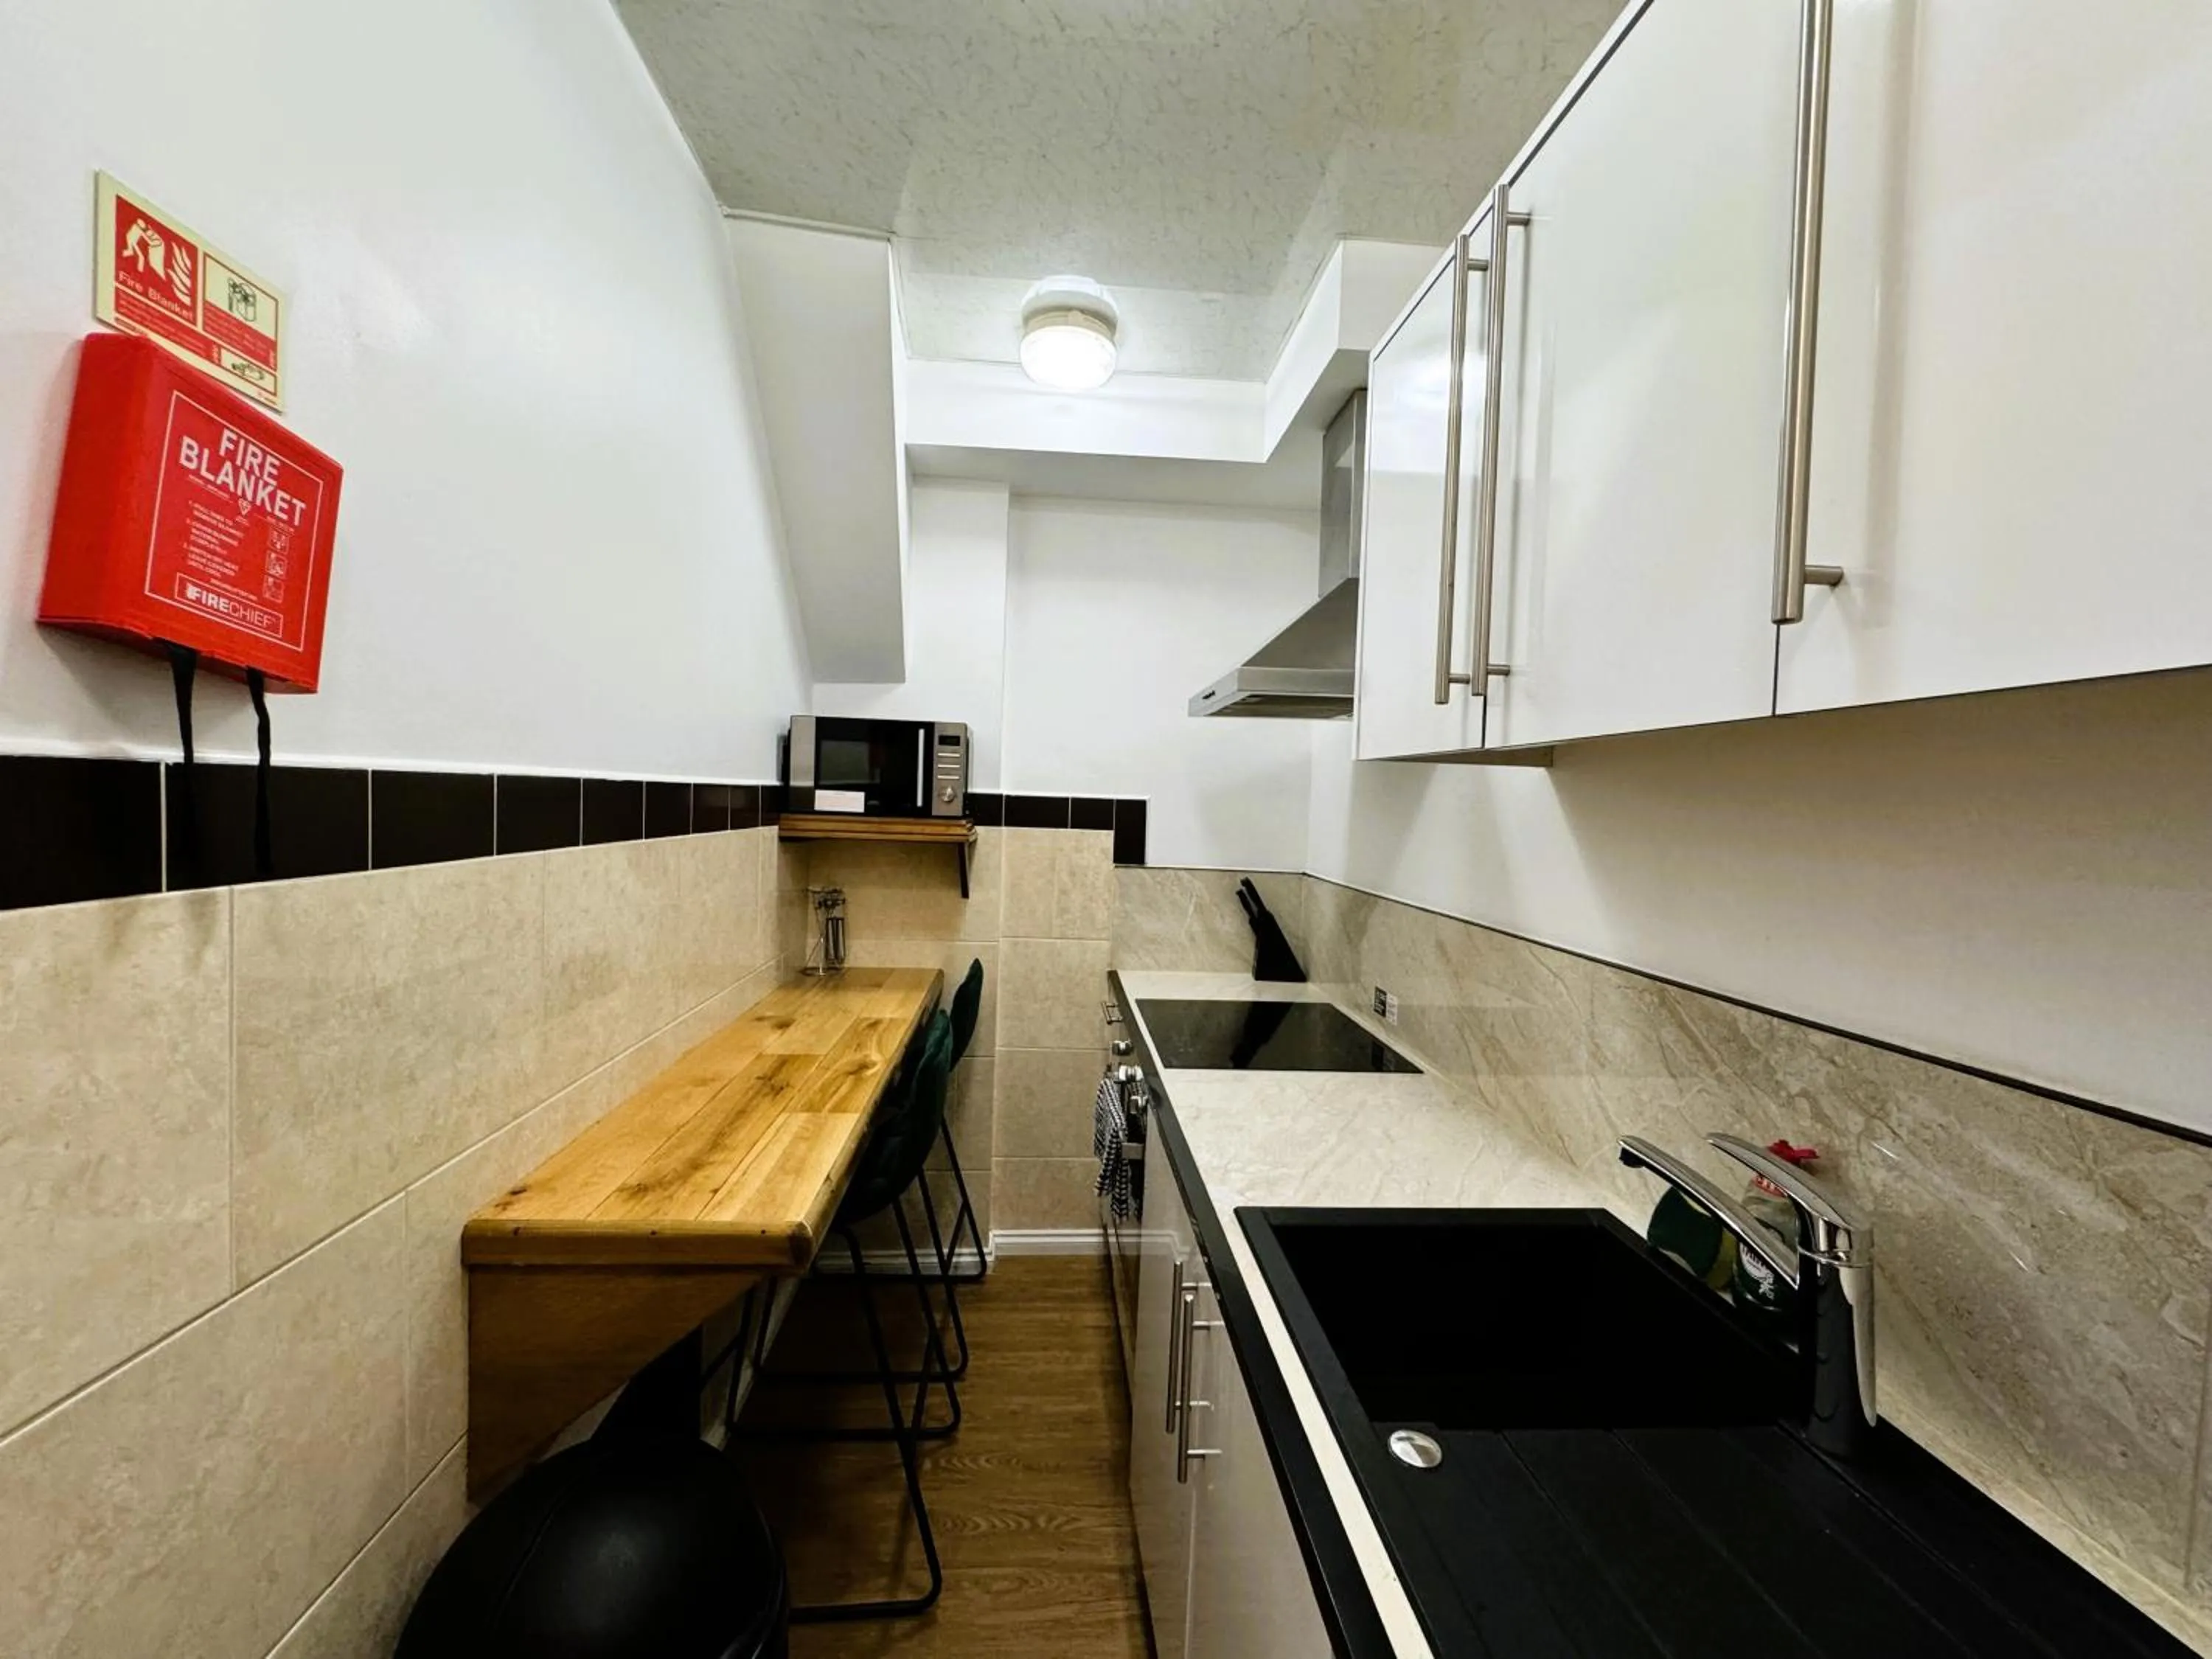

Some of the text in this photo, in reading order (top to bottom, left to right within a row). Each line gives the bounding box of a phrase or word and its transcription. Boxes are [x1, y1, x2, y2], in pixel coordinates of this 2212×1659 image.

[119, 270, 193, 321] Fire Blanket
[178, 436, 306, 526] BLANKET
[219, 428, 281, 485] FIRE
[187, 582, 272, 627] FIRECHIEF
